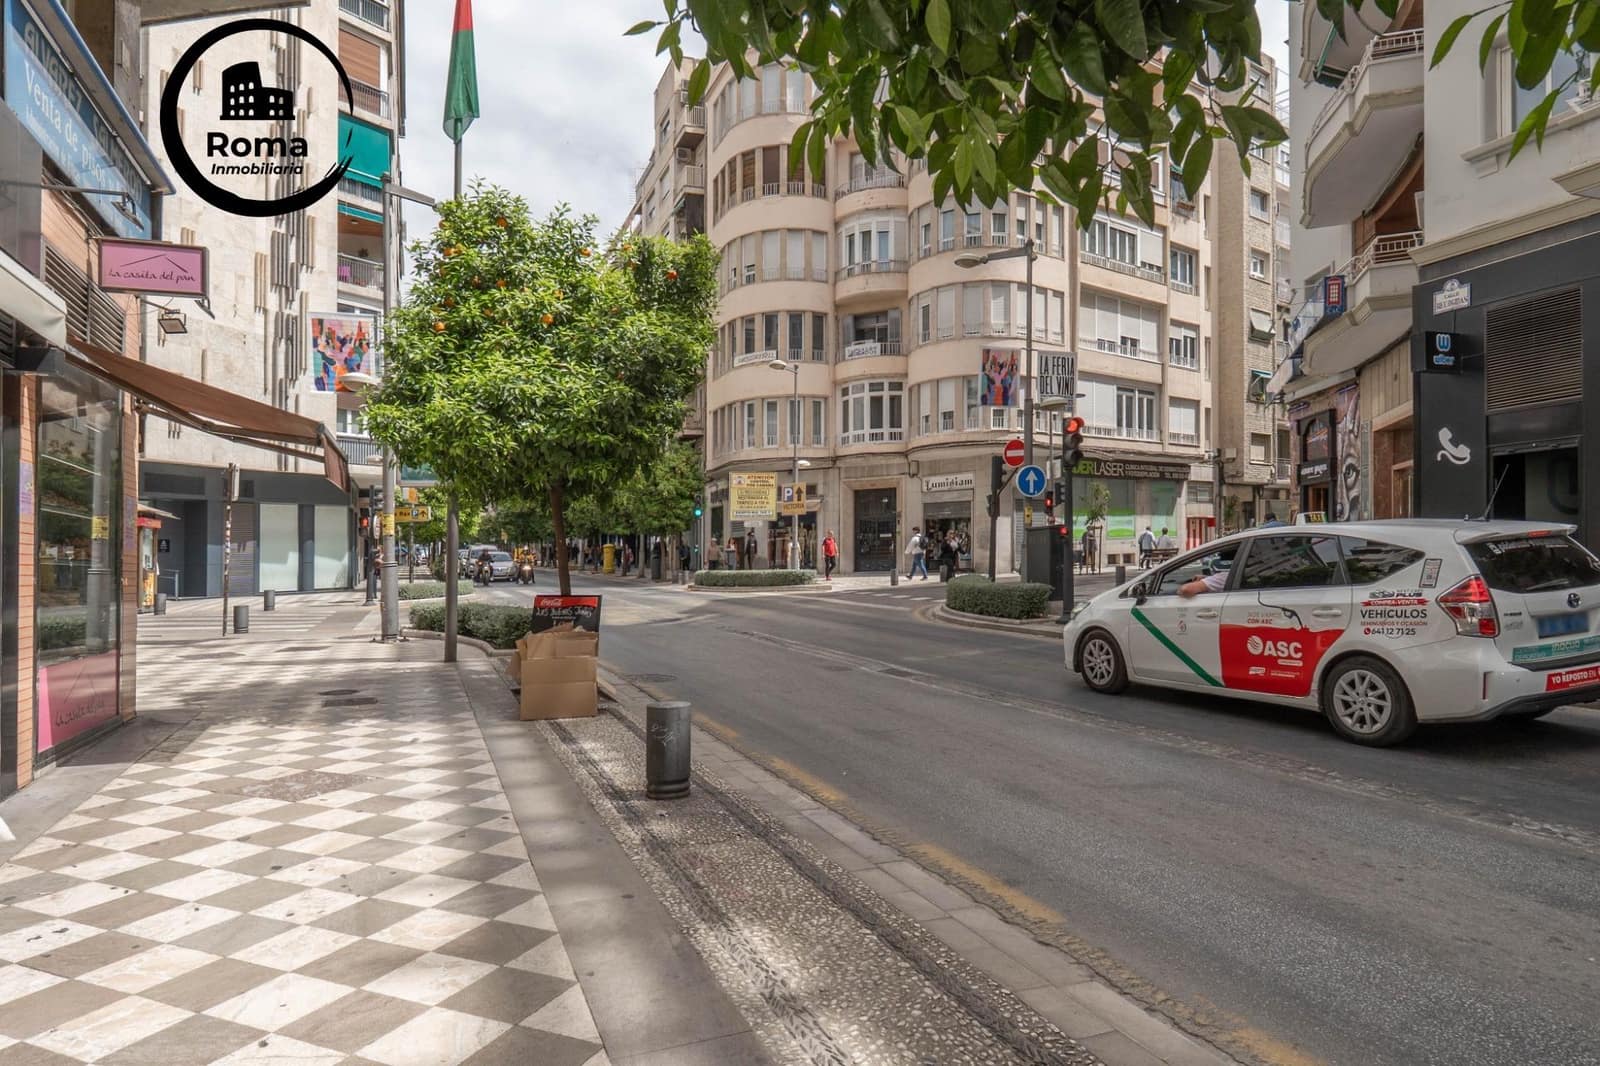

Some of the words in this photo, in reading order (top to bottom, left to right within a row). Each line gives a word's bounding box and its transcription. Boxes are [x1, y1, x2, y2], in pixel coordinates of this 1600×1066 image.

[24, 59, 62, 132] Venta
[65, 118, 78, 152] de
[123, 269, 157, 279] casita
[159, 270, 174, 281] del
[176, 275, 196, 284] pan
[1040, 355, 1050, 375] LA
[1052, 356, 1075, 376] FERIA
[1040, 375, 1055, 394] DEL
[1056, 375, 1075, 397] VINO
[1094, 461, 1125, 477] LASER
[784, 487, 793, 501] P
[1360, 608, 1428, 619] VEHÍCULOS
[1264, 640, 1303, 659] ASC
[1551, 676, 1561, 684] YO
[1562, 671, 1588, 681] REPOSTO
